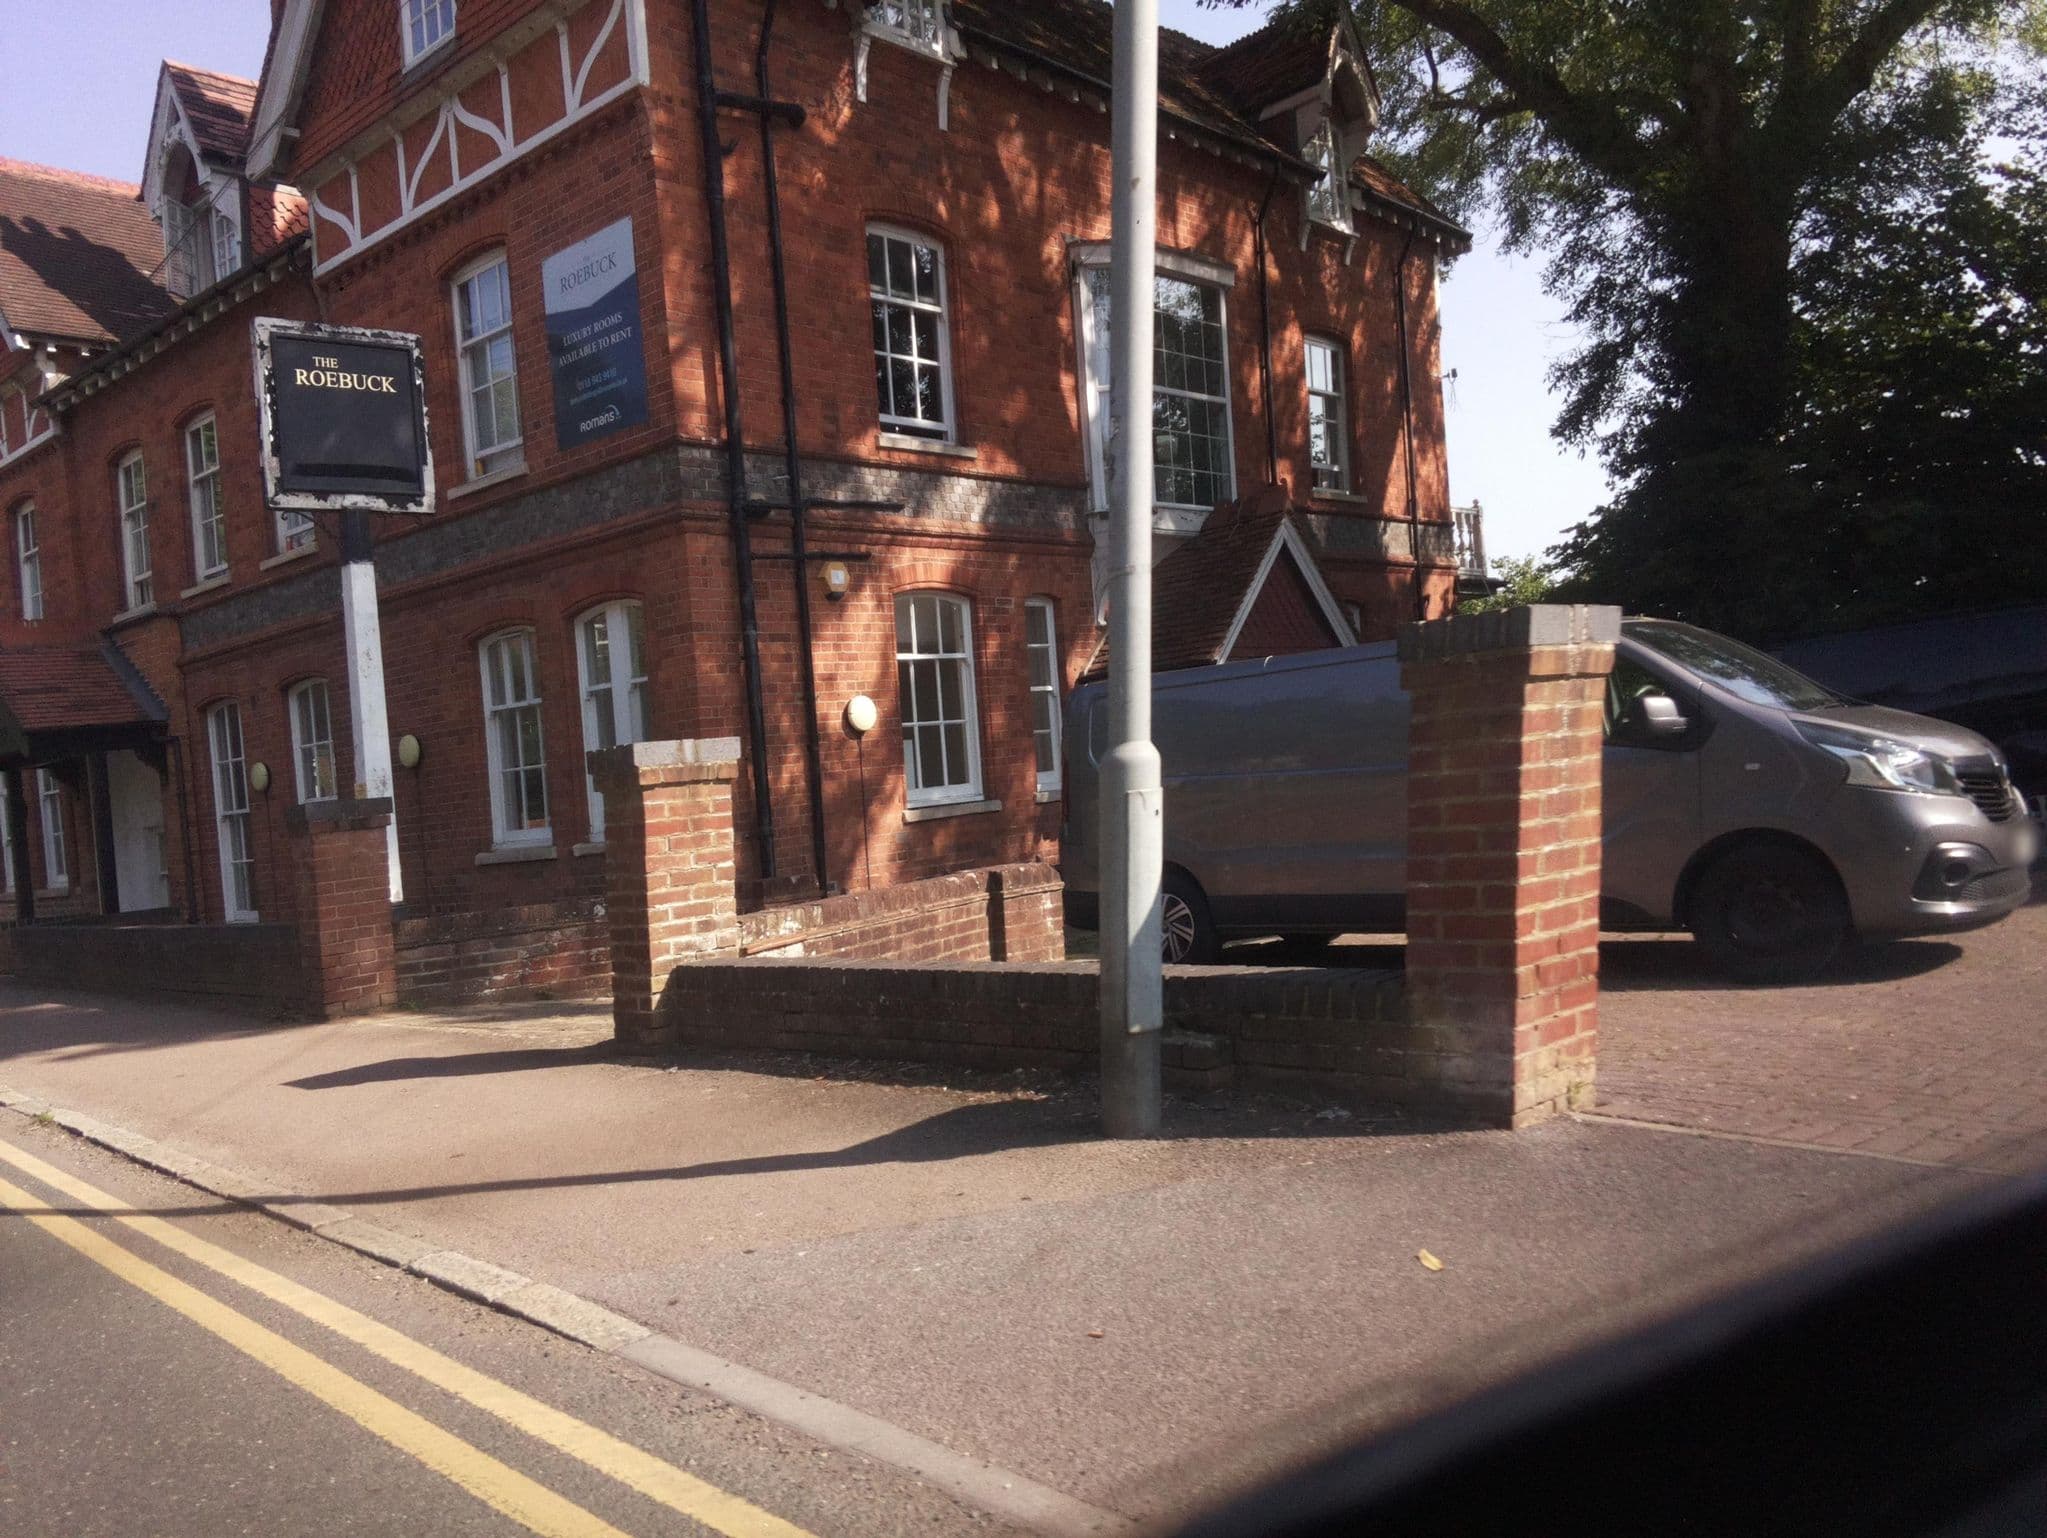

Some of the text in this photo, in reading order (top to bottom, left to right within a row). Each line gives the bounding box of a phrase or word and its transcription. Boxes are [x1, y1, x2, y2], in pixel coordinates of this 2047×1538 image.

[560, 252, 617, 294] ROEBUCK
[562, 311, 624, 347] LUXURY ROOMS
[312, 356, 339, 369] THE
[559, 326, 633, 369] AVAILABLE TO RENT
[294, 368, 398, 393] ROEBUCK
